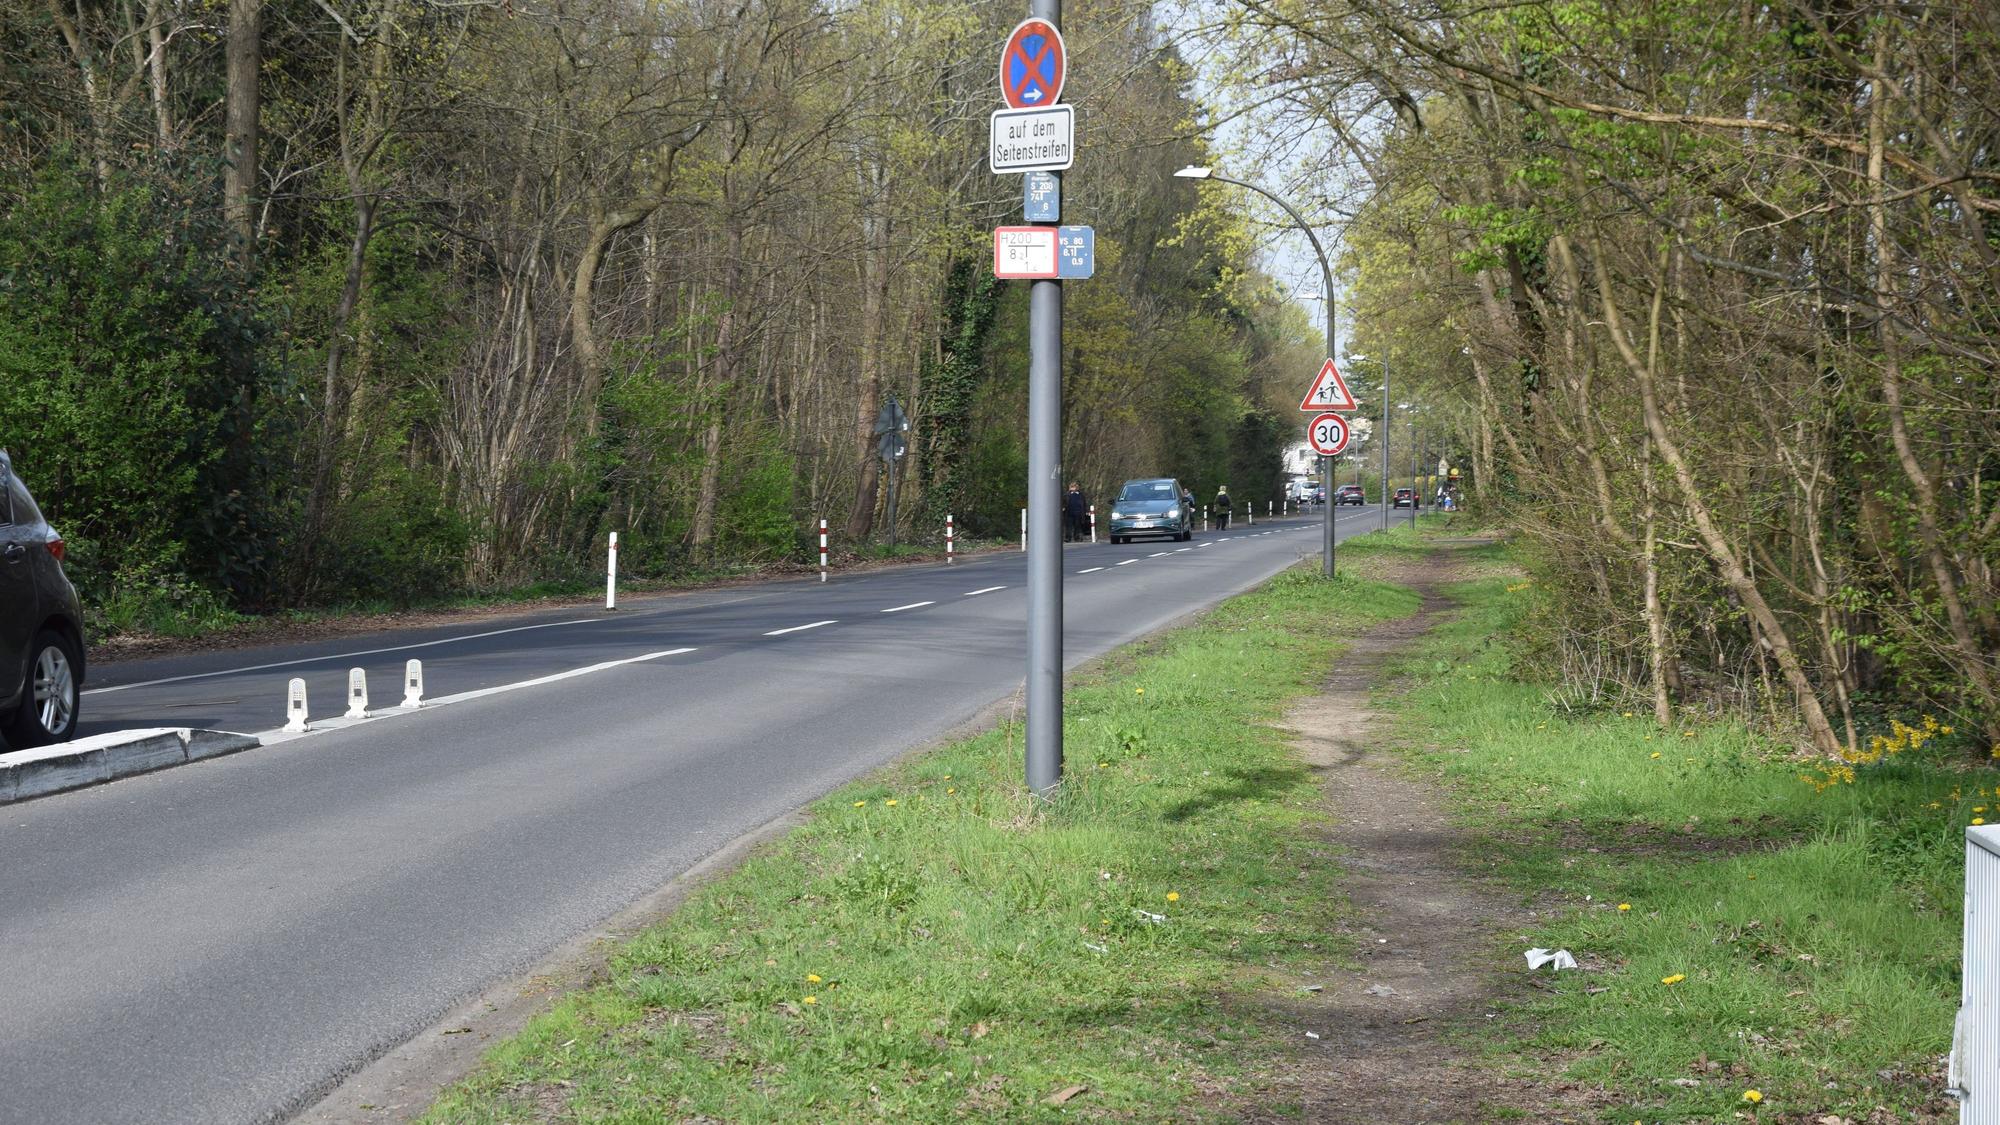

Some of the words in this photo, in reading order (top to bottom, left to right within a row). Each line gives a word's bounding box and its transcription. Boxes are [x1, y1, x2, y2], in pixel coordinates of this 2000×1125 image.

[1008, 119, 1027, 139] auf
[1033, 118, 1055, 137] dem
[996, 139, 1067, 162] Seitenstreifen
[1040, 182, 1053, 190] 200
[1317, 425, 1340, 443] 30
